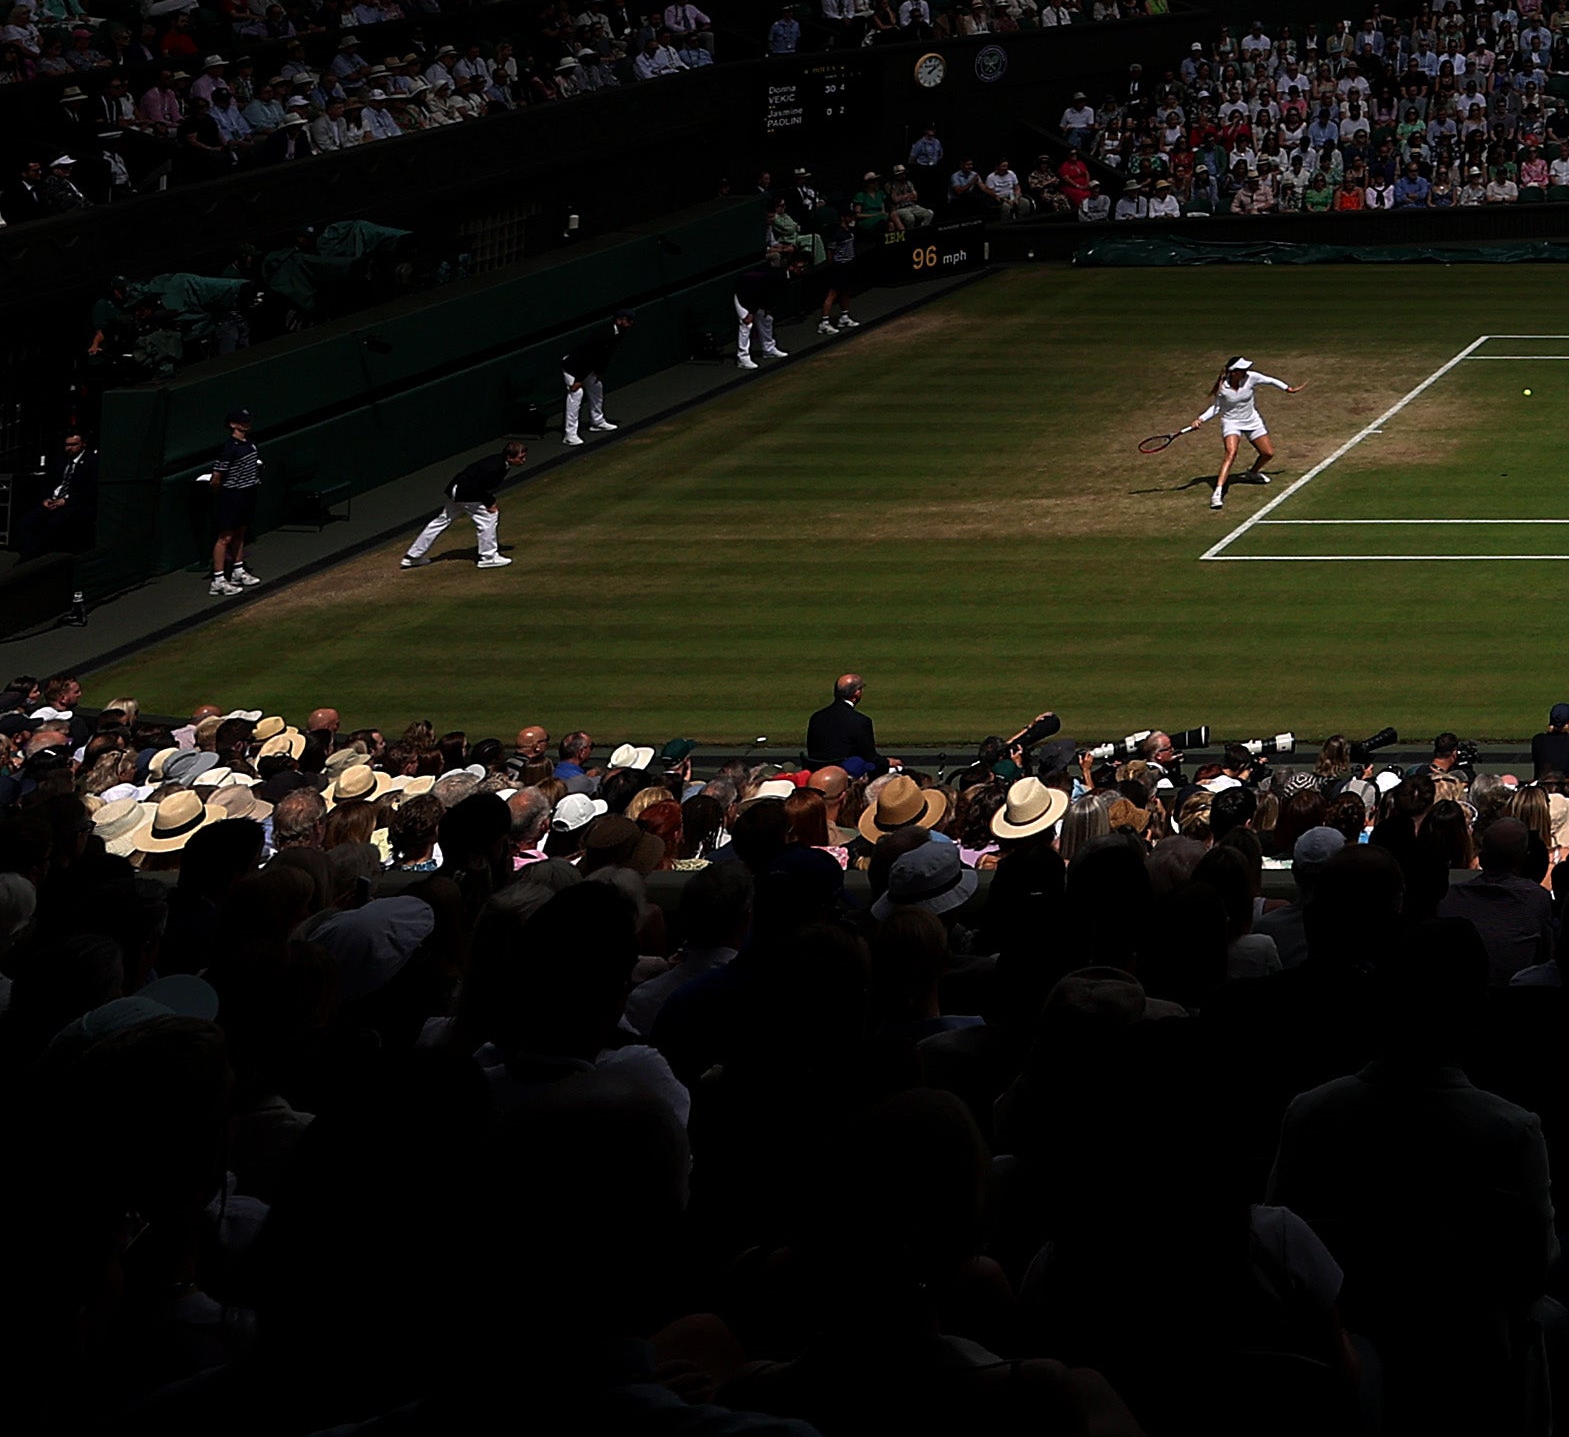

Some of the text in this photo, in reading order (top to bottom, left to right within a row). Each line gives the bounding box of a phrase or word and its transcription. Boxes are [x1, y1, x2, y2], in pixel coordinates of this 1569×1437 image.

[769, 85, 797, 94] Donna
[825, 85, 836, 94] 30
[768, 94, 796, 104] VEKIC
[767, 116, 802, 127] PAOLINI
[884, 230, 906, 245] IBM
[912, 245, 967, 270] 96 mph
